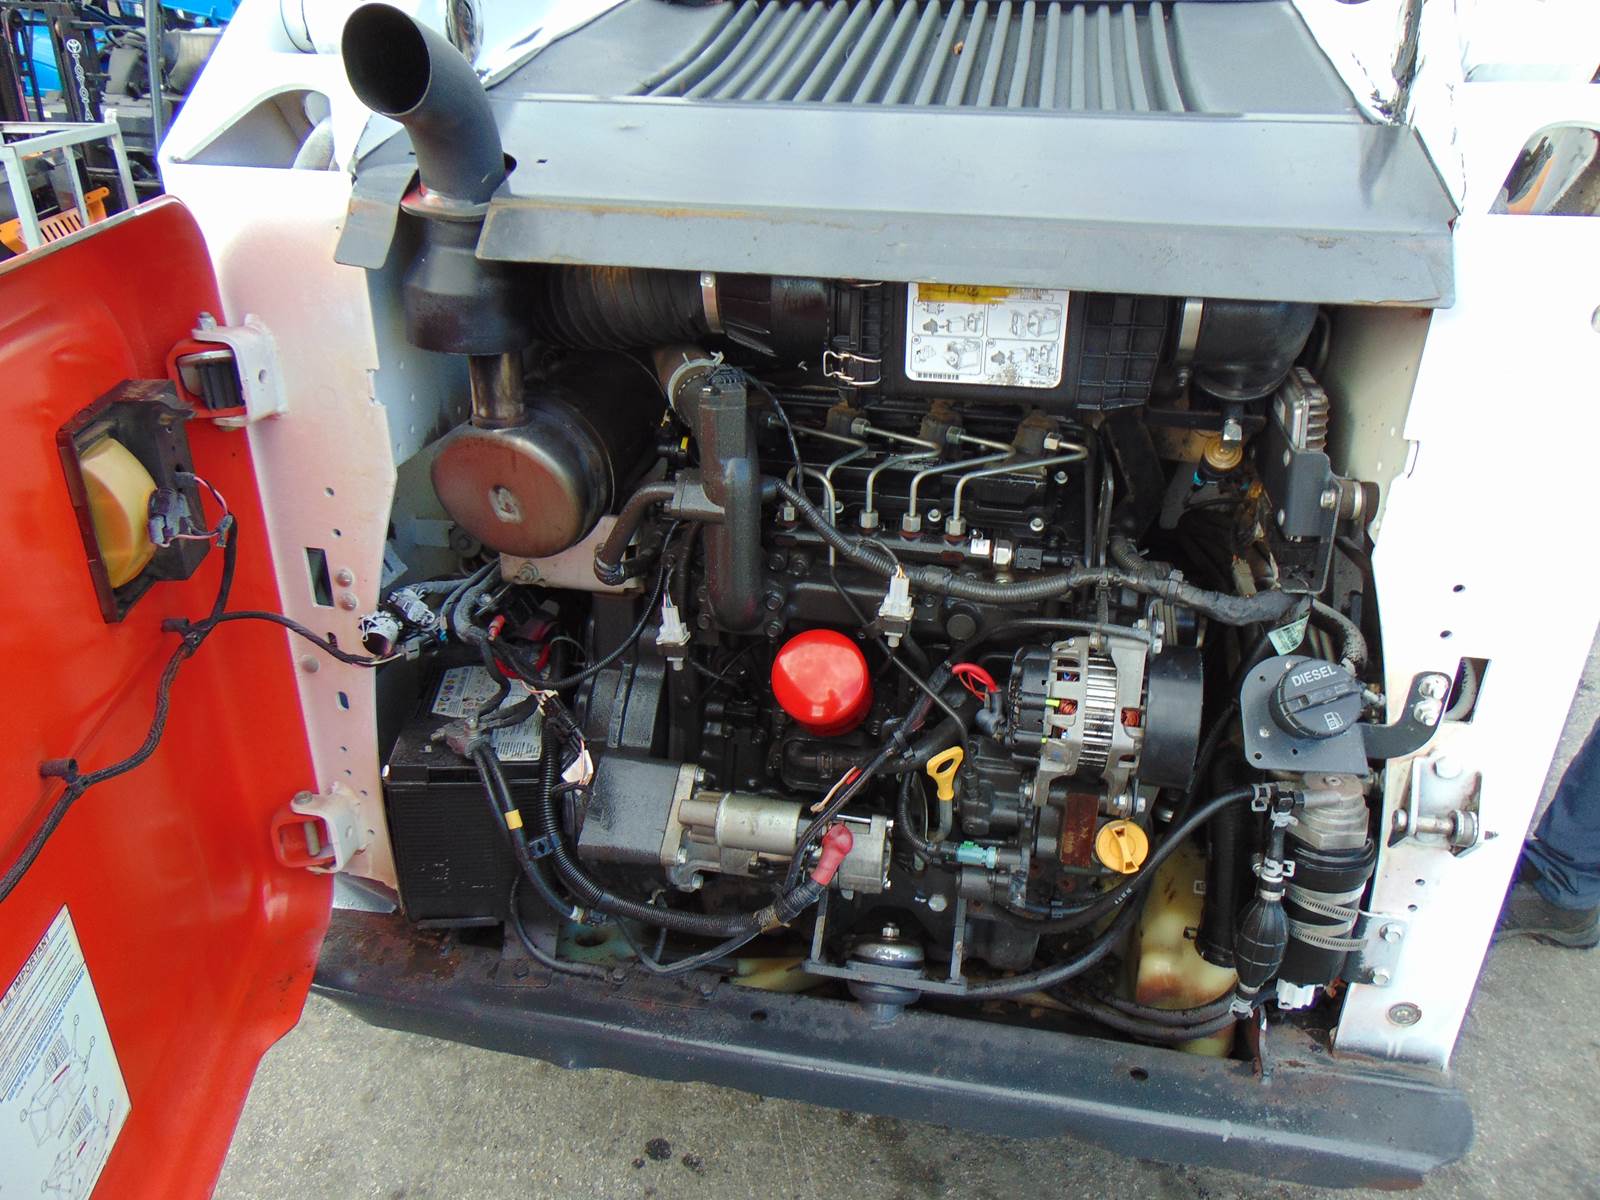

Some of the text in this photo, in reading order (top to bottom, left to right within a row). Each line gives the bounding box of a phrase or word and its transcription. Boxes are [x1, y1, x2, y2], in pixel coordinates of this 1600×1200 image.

[72, 54, 95, 121] TOYOTA
[1291, 665, 1337, 687] DIESEL
[13, 934, 50, 991] IMPORTANT
[7, 1061, 32, 1102] GENERAL
